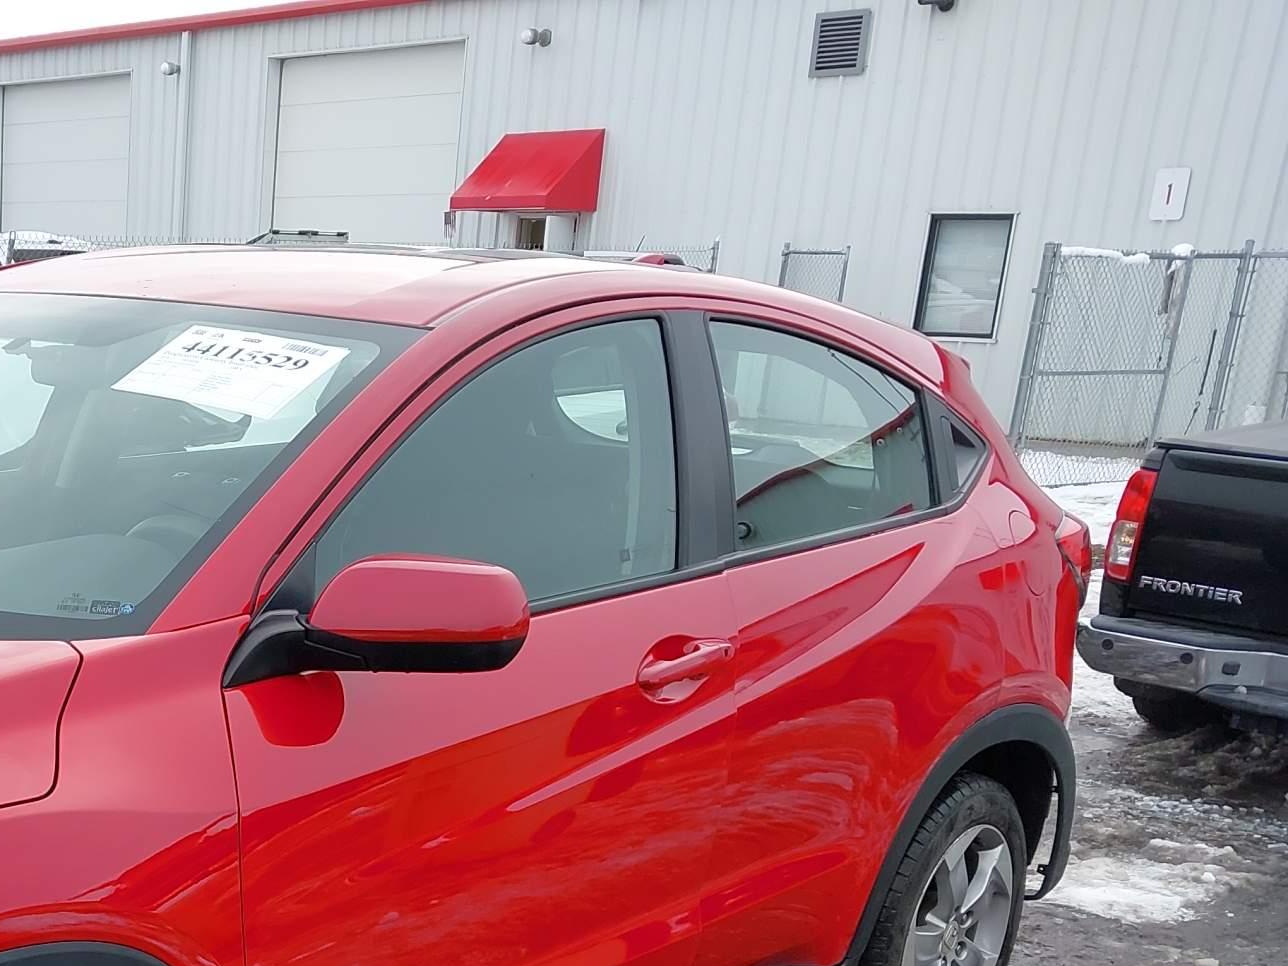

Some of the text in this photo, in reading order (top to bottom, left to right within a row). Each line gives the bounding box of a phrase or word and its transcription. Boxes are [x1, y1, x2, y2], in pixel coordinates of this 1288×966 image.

[1166, 183, 1173, 205] 1
[182, 340, 310, 372] 44115529
[1138, 575, 1243, 605] FRONTIER
